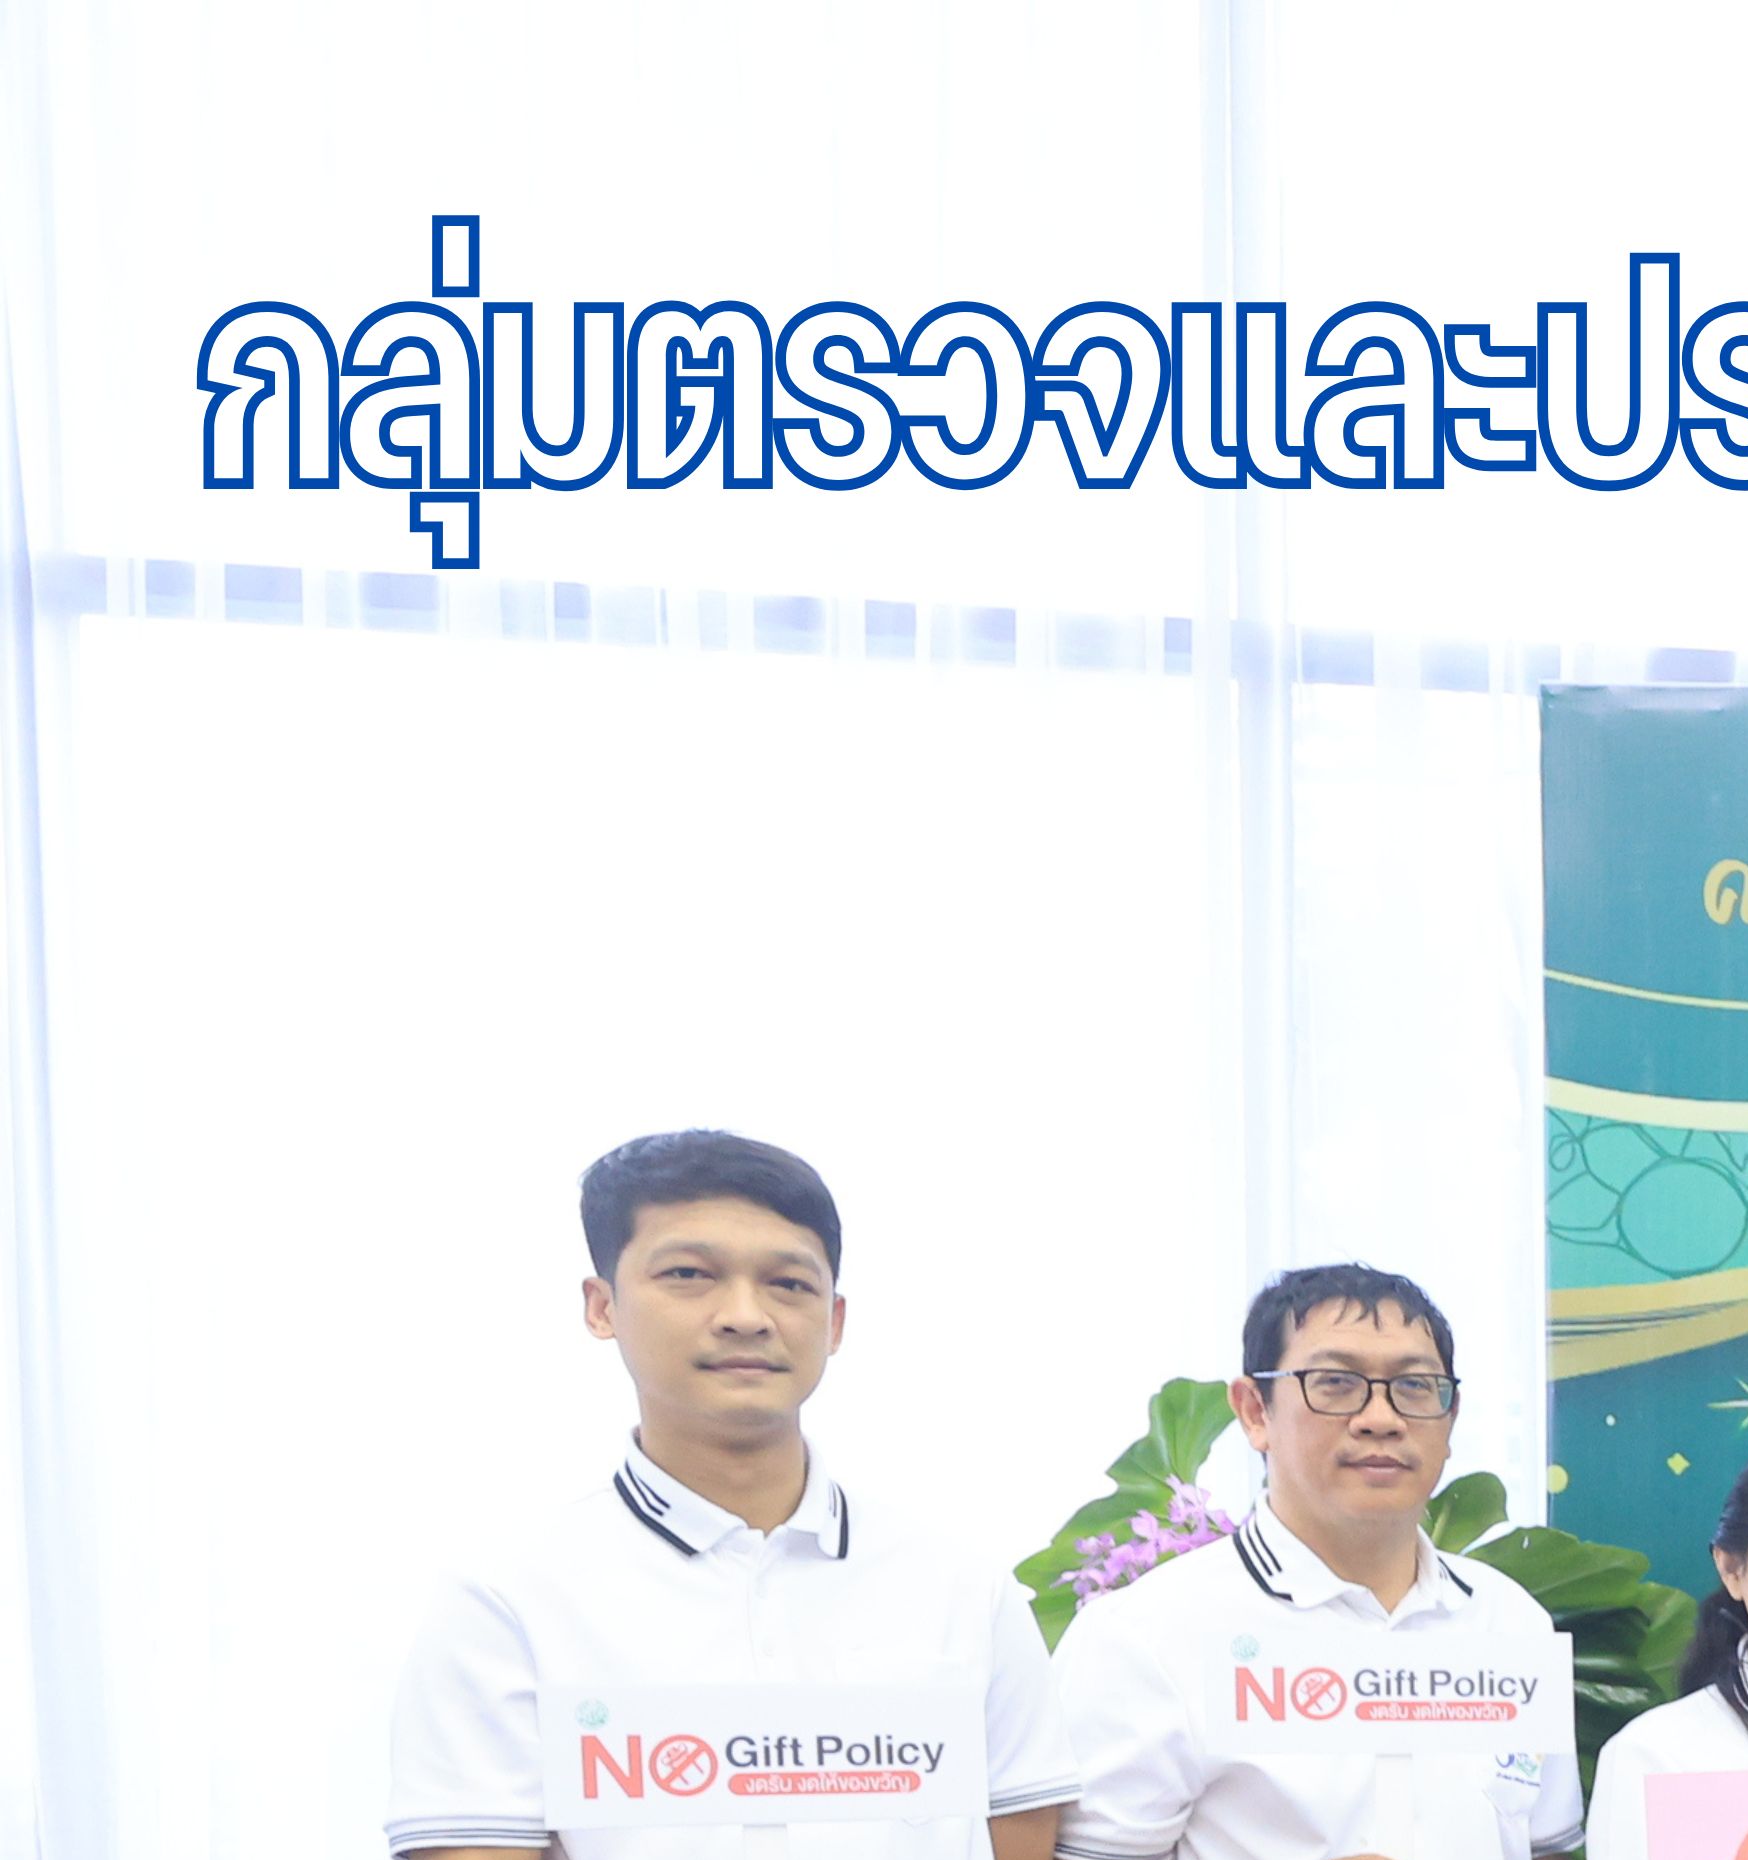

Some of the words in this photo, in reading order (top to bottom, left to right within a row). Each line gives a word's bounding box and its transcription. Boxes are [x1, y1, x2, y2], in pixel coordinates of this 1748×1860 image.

[1353, 1669, 1418, 1697] Gift
[1429, 1670, 1538, 1704] Policy
[725, 1735, 802, 1768] Gift
[816, 1734, 944, 1773] Policy
